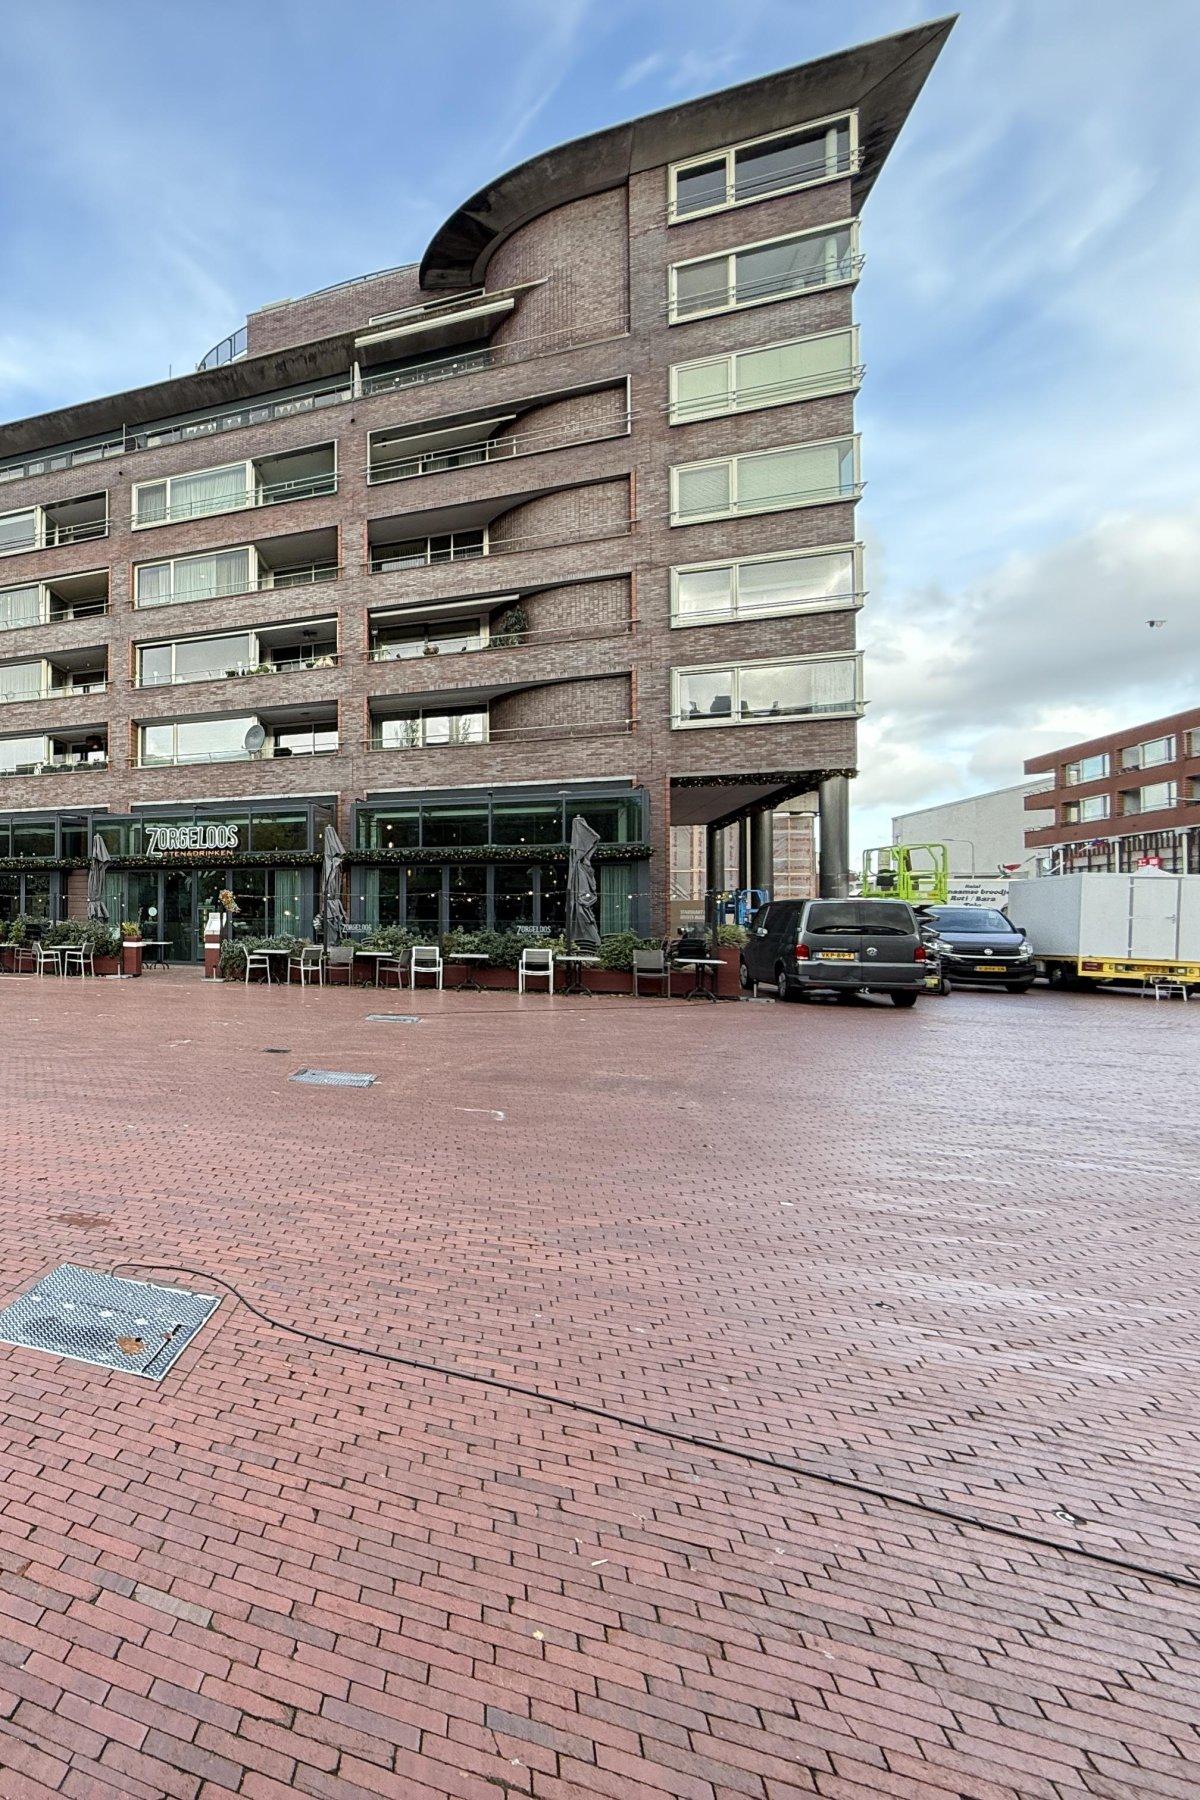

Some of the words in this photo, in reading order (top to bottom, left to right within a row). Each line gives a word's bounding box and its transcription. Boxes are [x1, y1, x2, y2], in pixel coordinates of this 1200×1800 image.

[145, 825, 238, 857] ZORGELOOS
[342, 923, 372, 933] ZORGELOOS
[517, 925, 552, 936] ZORGELOOS
